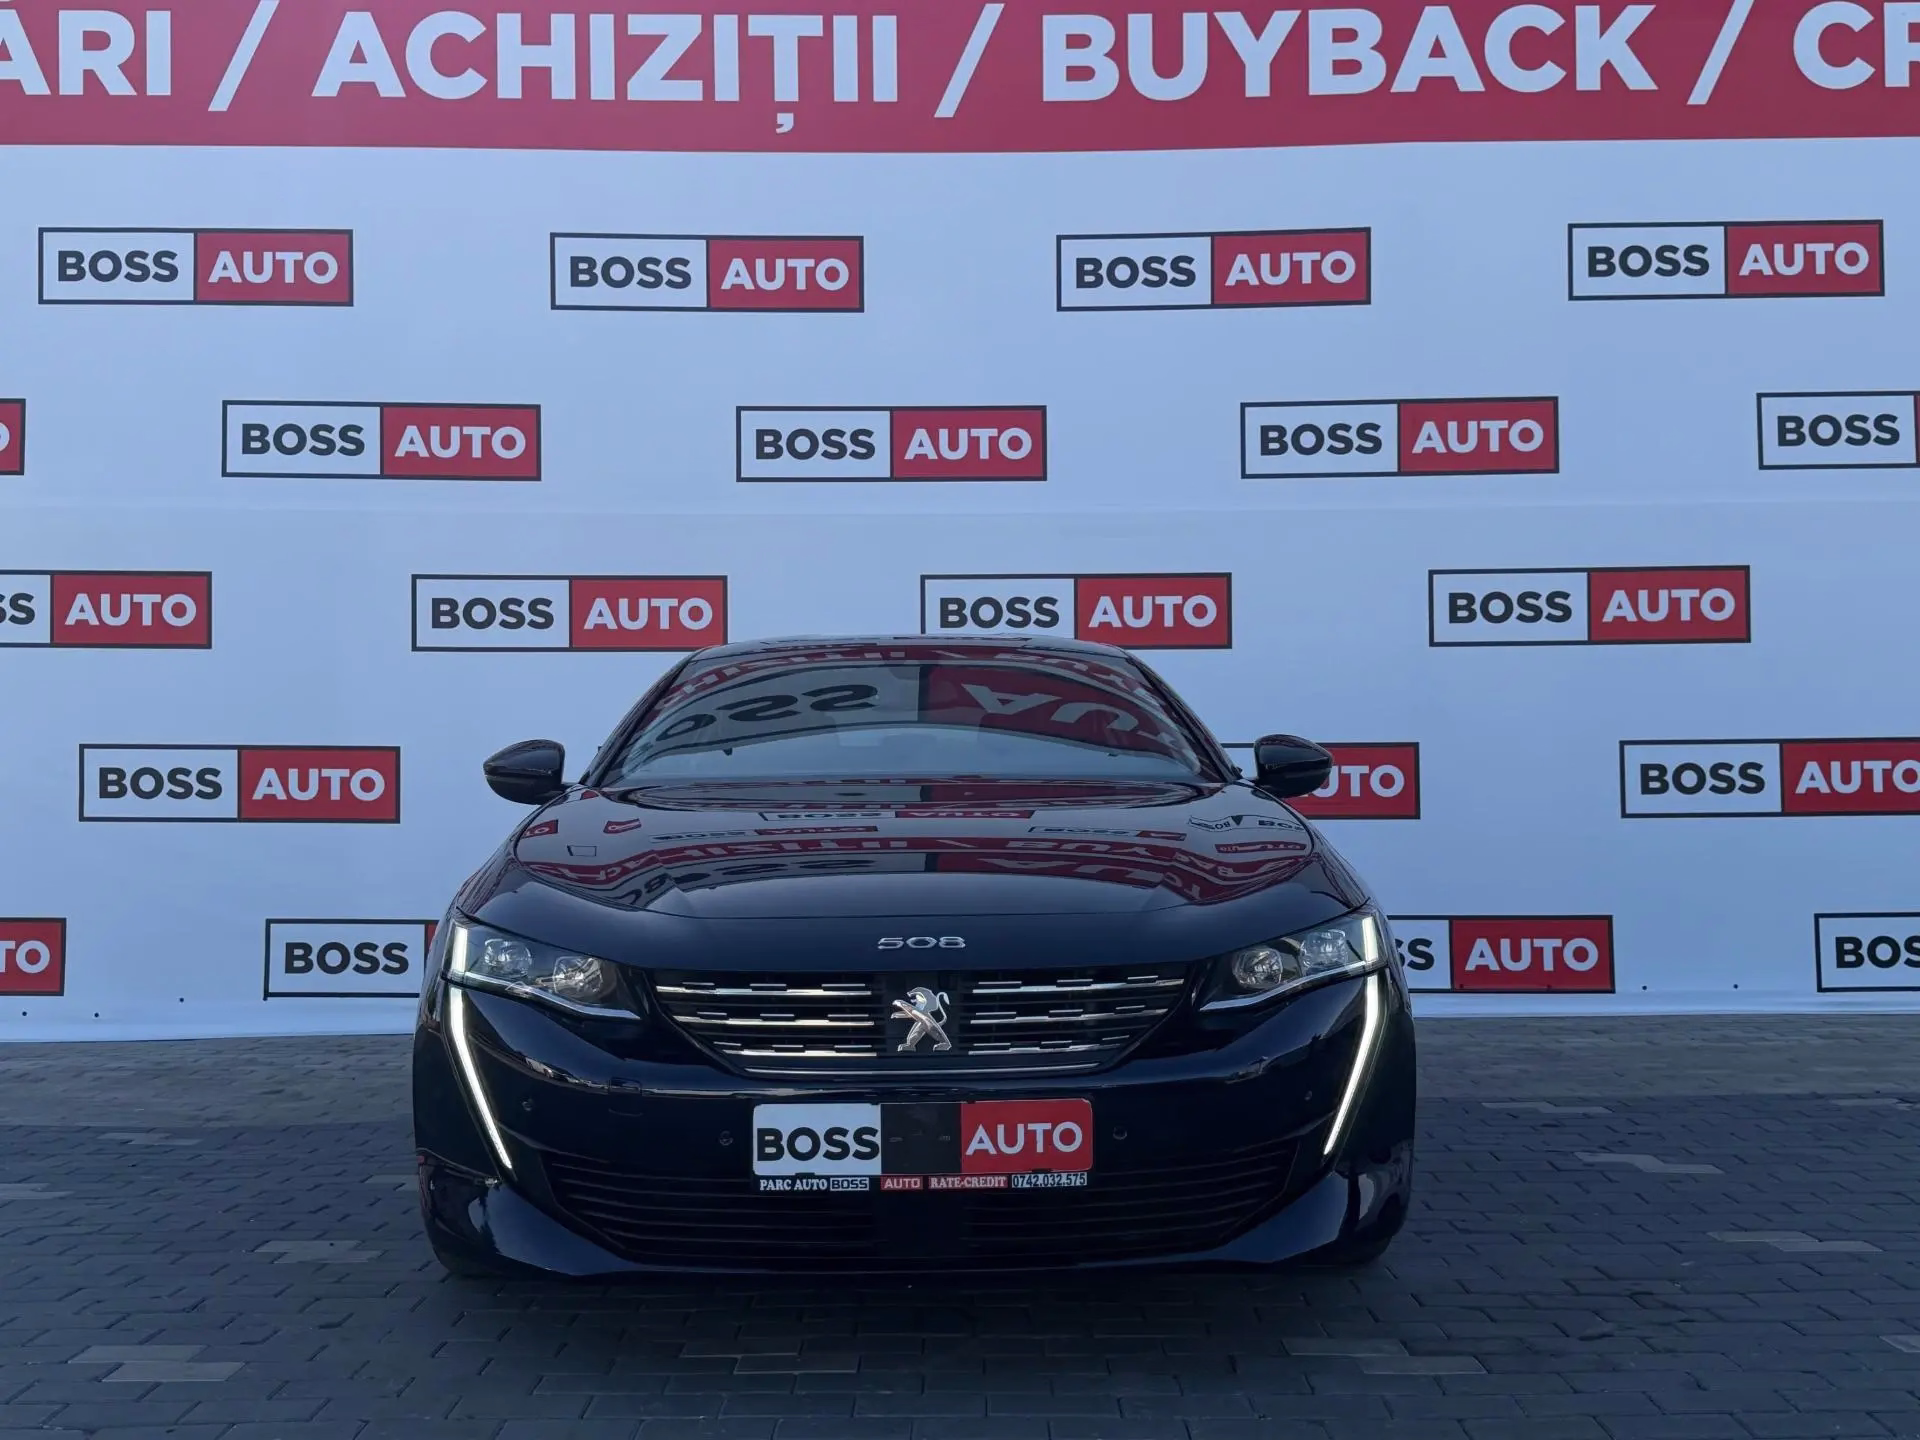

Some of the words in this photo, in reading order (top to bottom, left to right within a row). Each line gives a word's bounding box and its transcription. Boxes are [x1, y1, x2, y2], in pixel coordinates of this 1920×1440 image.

[312, 10, 898, 134] ACHIZIȚII
[1043, 4, 1658, 101] BUYBACK
[58, 250, 179, 283] BOSS
[208, 250, 339, 285] AUTO
[570, 256, 692, 289] BOSS
[721, 258, 849, 290] AUTO
[1076, 255, 1196, 288] BOSS
[1225, 250, 1356, 285] AUTO
[1588, 244, 1710, 278] BOSS
[1740, 242, 1869, 276] AUTO
[241, 424, 365, 457] BOSS
[395, 426, 526, 459] AUTO
[755, 429, 876, 460] BOSS
[905, 428, 1032, 460] AUTO
[1260, 422, 1382, 456] BOSS
[1412, 419, 1544, 453] AUTO
[1777, 413, 1901, 447] BOSS
[0, 592, 35, 625] S
[65, 593, 197, 627] AUTO
[431, 597, 555, 630] BOSS
[584, 597, 713, 630] AUTO
[939, 596, 1059, 629] BOSS
[1088, 594, 1217, 627] AUTO
[1449, 590, 1573, 624] BOSS
[1602, 588, 1735, 622] AUTO
[99, 766, 223, 799] BOSS
[252, 767, 385, 801] AUTO
[1300, 764, 1404, 798] UTO
[1640, 761, 1766, 795] BOSS
[1796, 759, 1920, 794] AUTO
[285, 941, 409, 975] BOSS
[877, 936, 966, 949] 508
[1465, 938, 1598, 971] AUTO
[757, 1126, 880, 1161] BOSS
[965, 1121, 1083, 1155] AUTO
[759, 1178, 791, 1191] PARC
[793, 1178, 828, 1191] AUTO
[831, 1178, 869, 1191] BOSS
[883, 1177, 921, 1190] AUTO
[930, 1175, 1007, 1189] RATE-CREDIT
[1012, 1173, 1086, 1188] 0742.032.575
